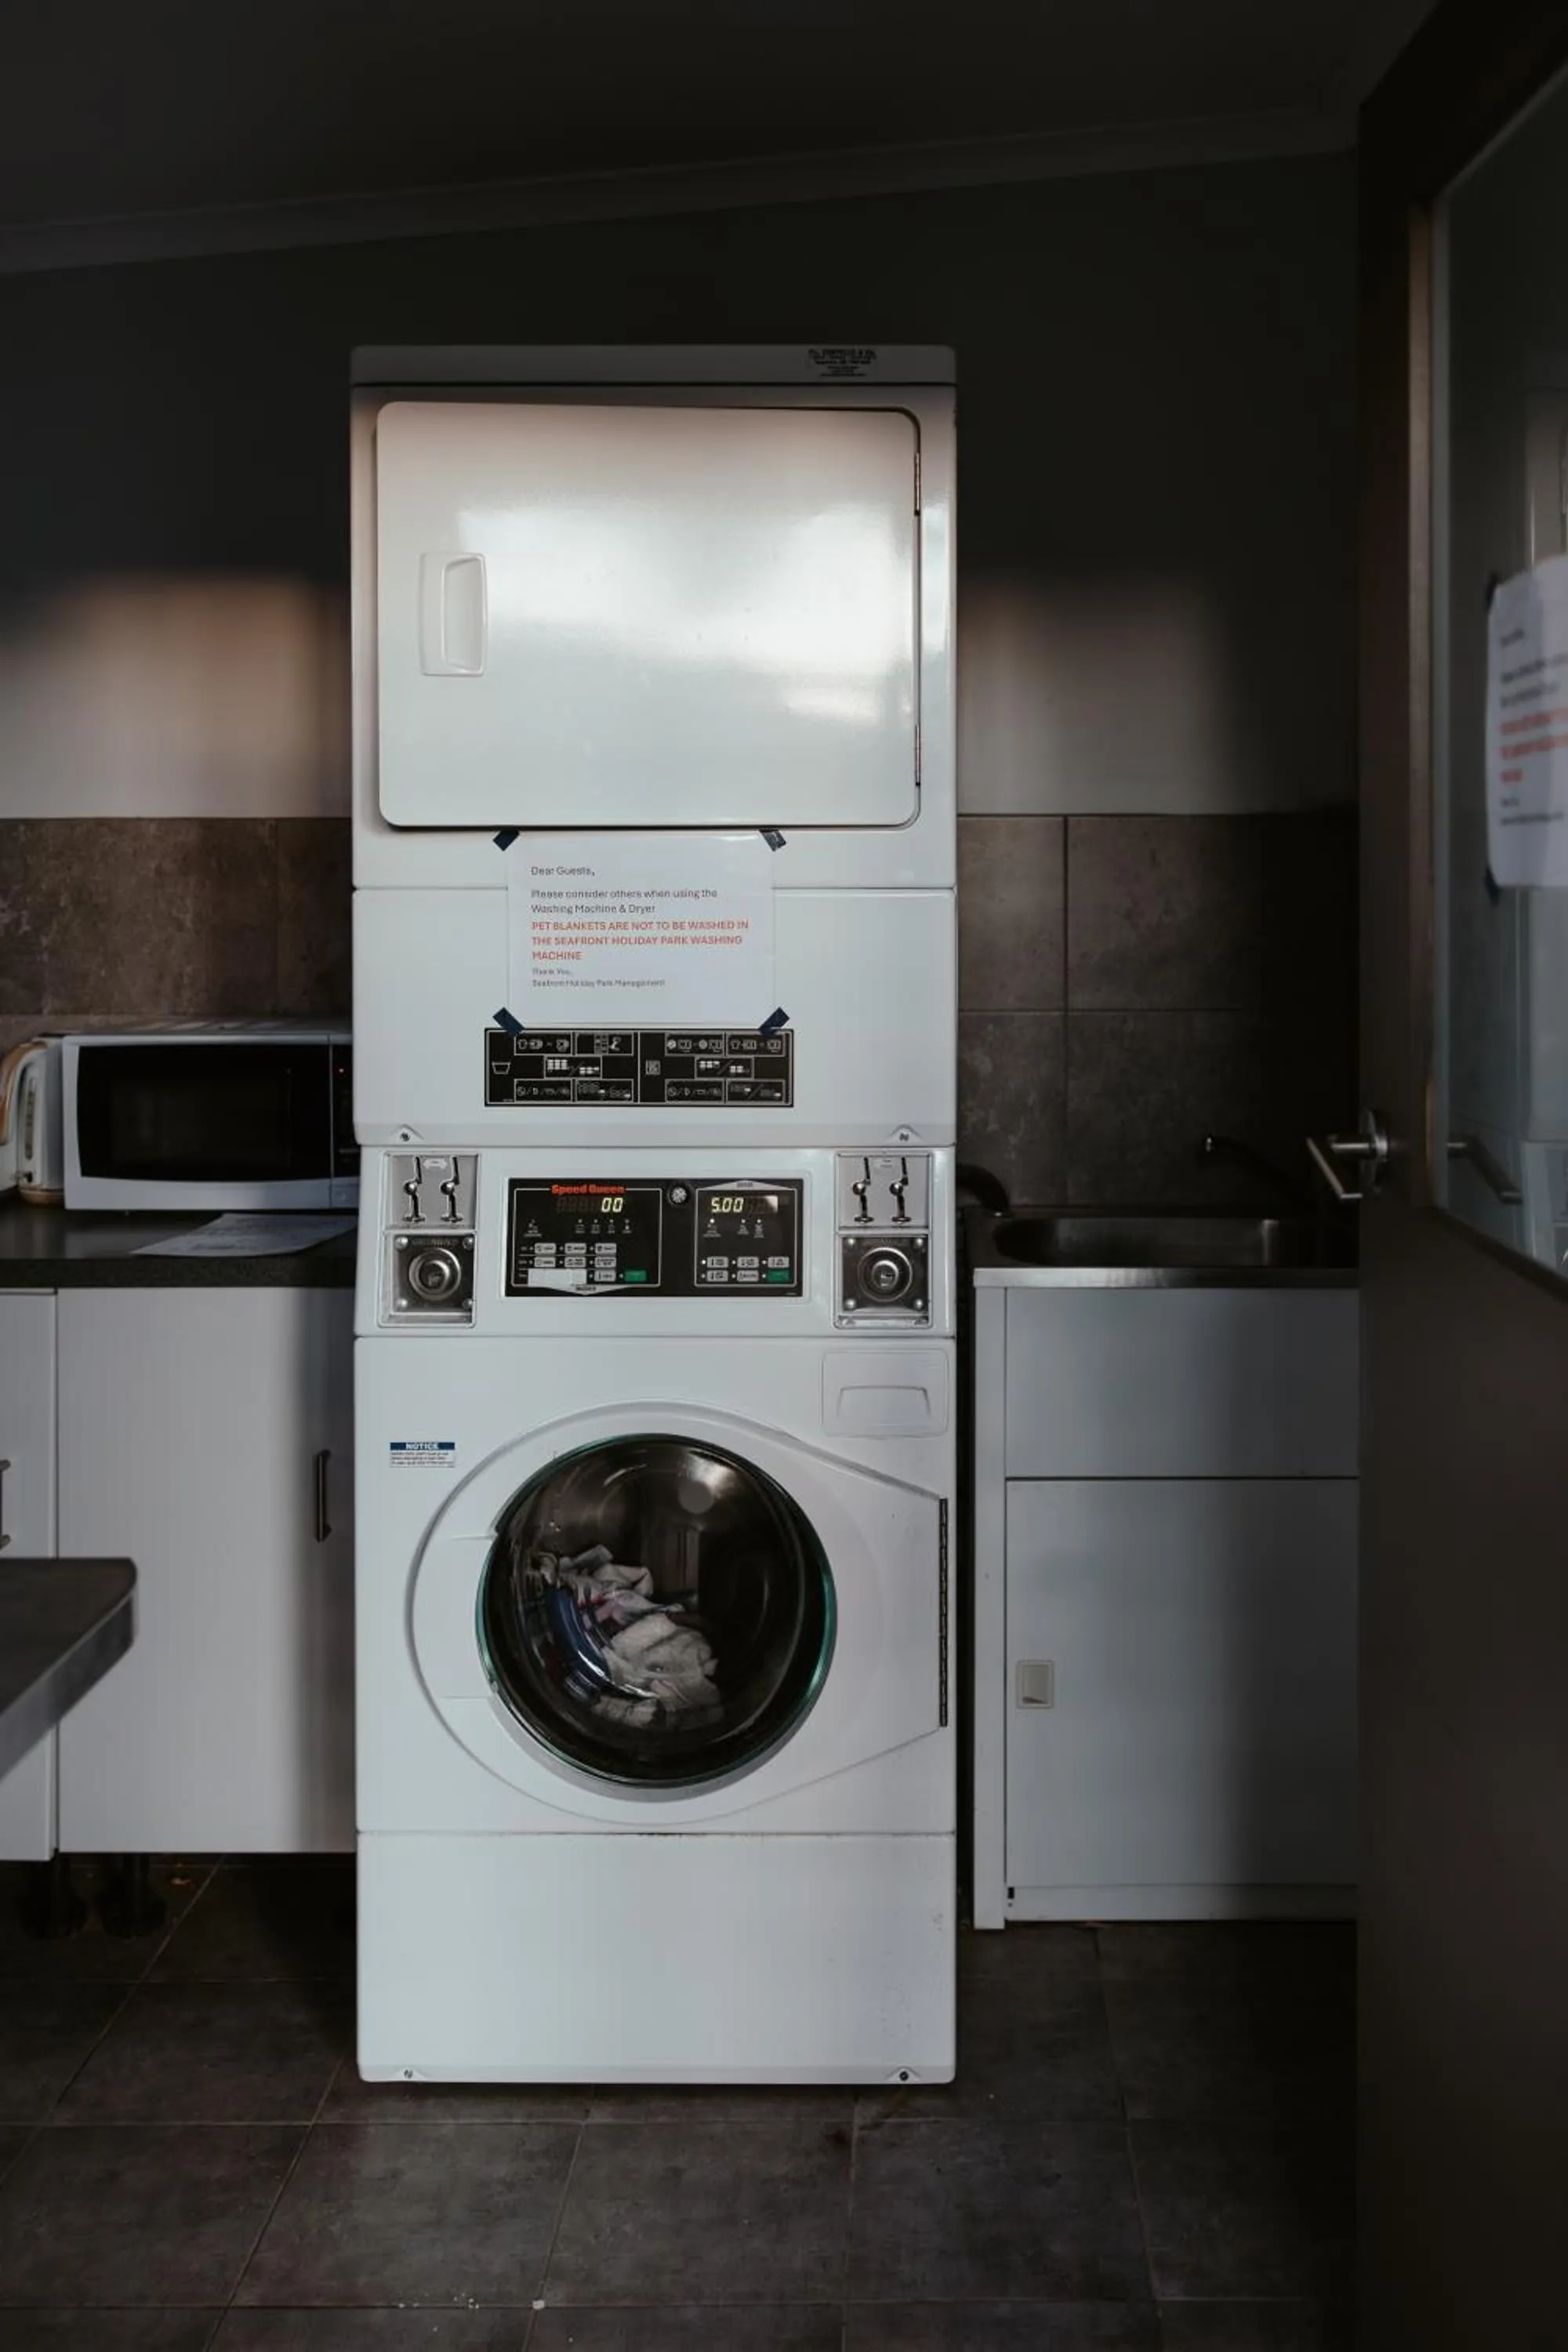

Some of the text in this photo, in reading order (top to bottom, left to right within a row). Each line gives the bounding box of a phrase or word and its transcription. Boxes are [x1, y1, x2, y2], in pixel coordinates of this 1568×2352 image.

[531, 866, 554, 875] Dear
[610, 889, 641, 898] others
[644, 889, 670, 898] when
[673, 889, 699, 899] using
[702, 889, 717, 898] the
[531, 905, 655, 915] Washing Machine & Dryer
[532, 920, 749, 931] PET BLANKETS ARE NOT TO BE WASHED IN
[532, 936, 743, 946] THE SEAFRONT HOLIDAY PARK WASHING
[532, 951, 583, 960] MACHINE
[551, 1184, 625, 1196] Speed Queen
[601, 1197, 623, 1213] 00
